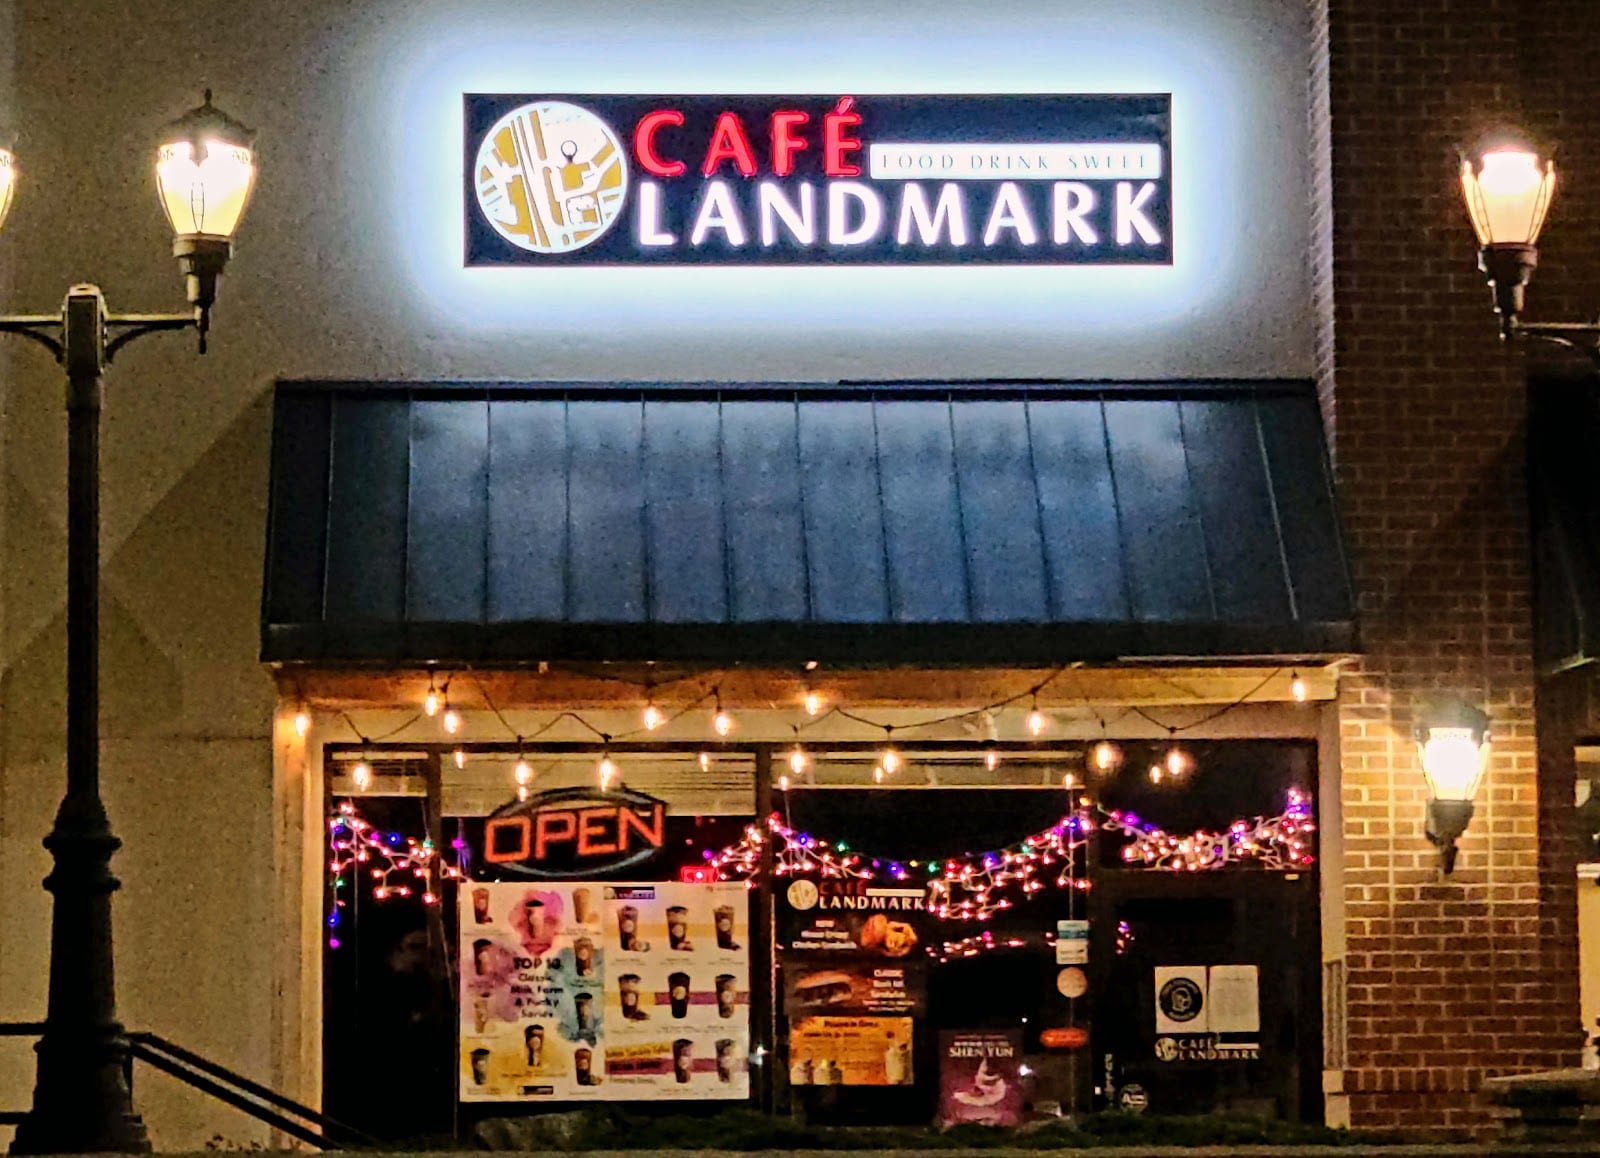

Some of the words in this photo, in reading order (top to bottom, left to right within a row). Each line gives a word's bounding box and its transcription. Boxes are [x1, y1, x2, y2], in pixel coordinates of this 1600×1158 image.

[634, 96, 862, 177] CAFÉ
[970, 153, 1049, 170] DRINK
[638, 181, 1163, 247] LANDMARK
[484, 803, 664, 863] OPEN
[819, 895, 925, 910] LANDMARK
[949, 1046, 984, 1058] SHEN
[987, 1046, 1014, 1058] YUN
[1178, 1049, 1259, 1060] LANDMARK
